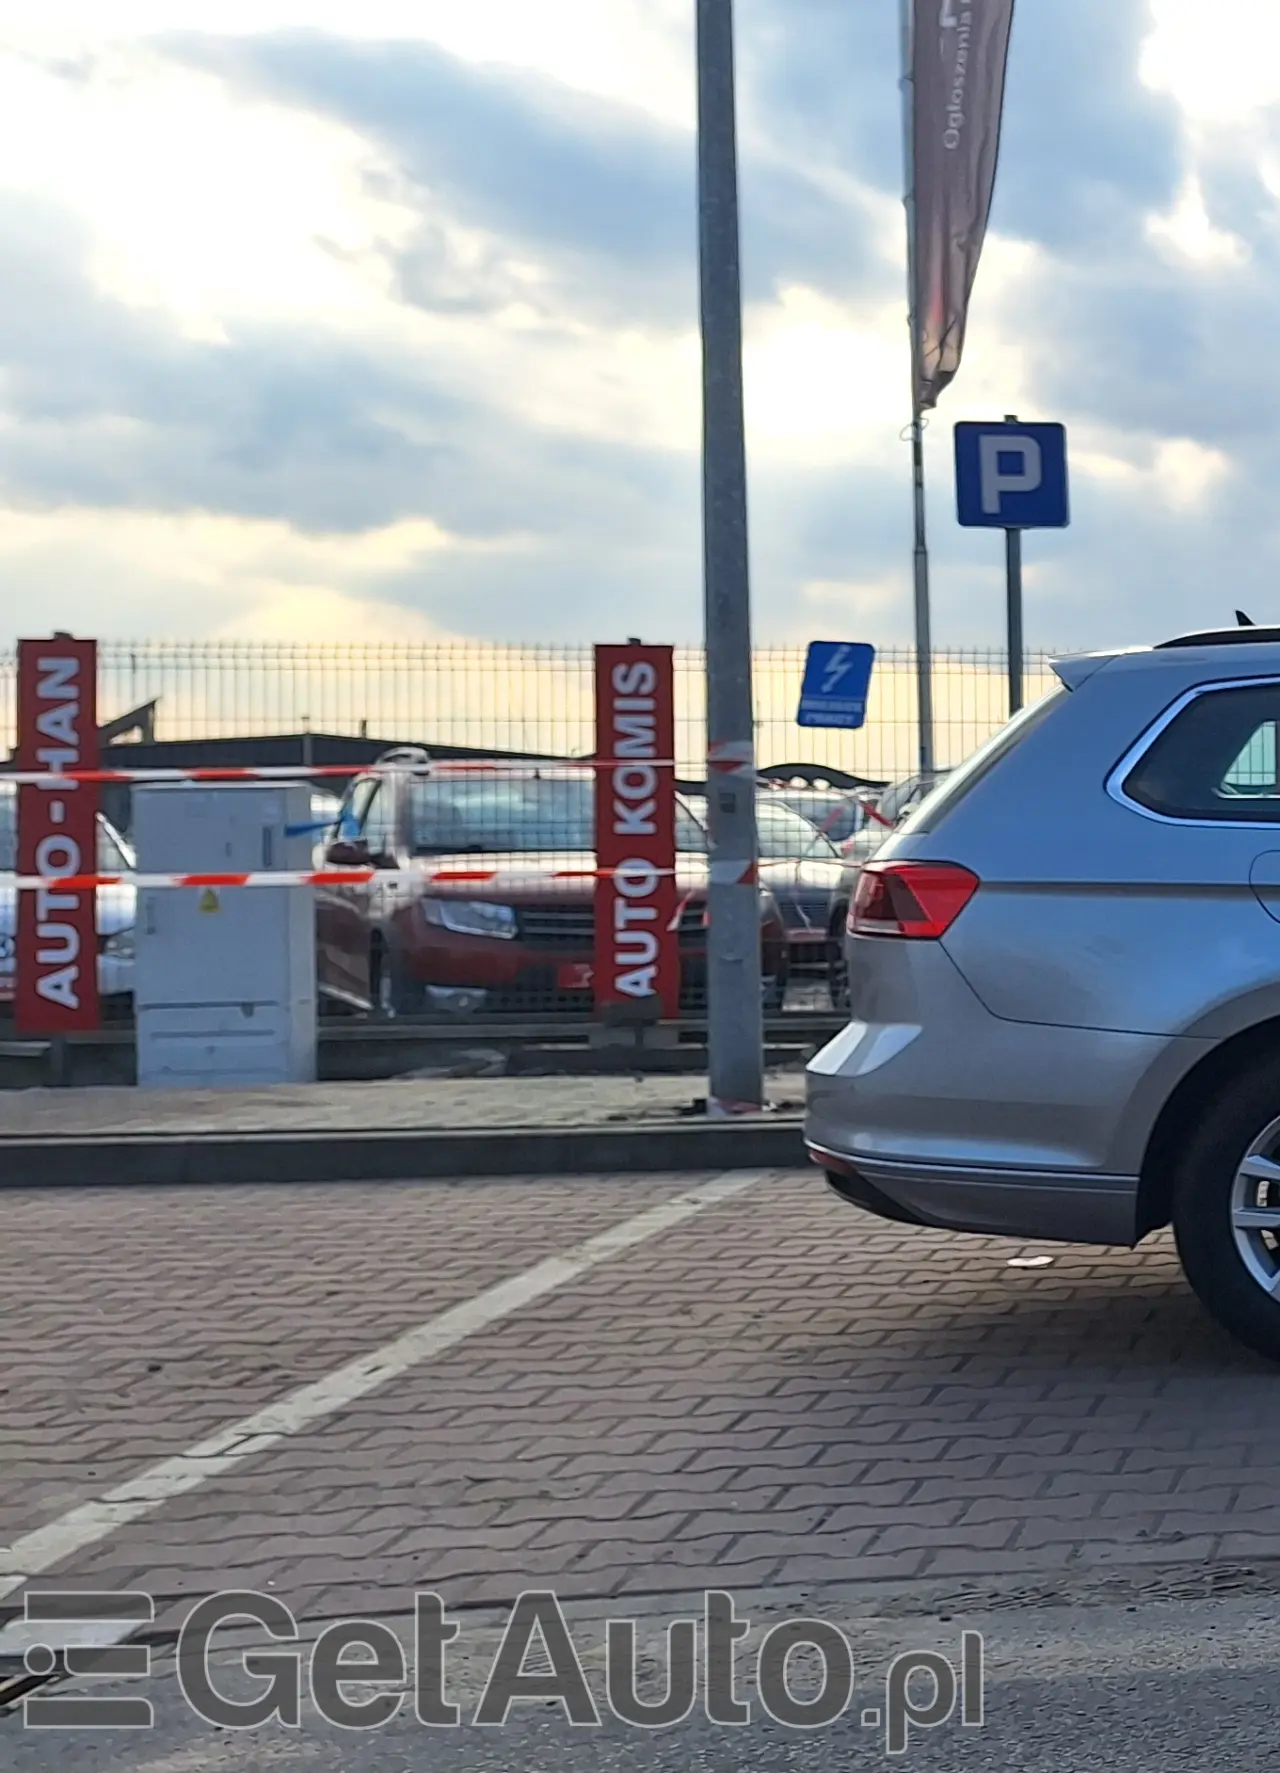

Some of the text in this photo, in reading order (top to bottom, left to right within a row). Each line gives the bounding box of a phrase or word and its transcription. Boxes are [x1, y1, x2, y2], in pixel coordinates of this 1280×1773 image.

[979, 434, 1041, 514] P
[612, 661, 658, 998] AUTO KOMIS
